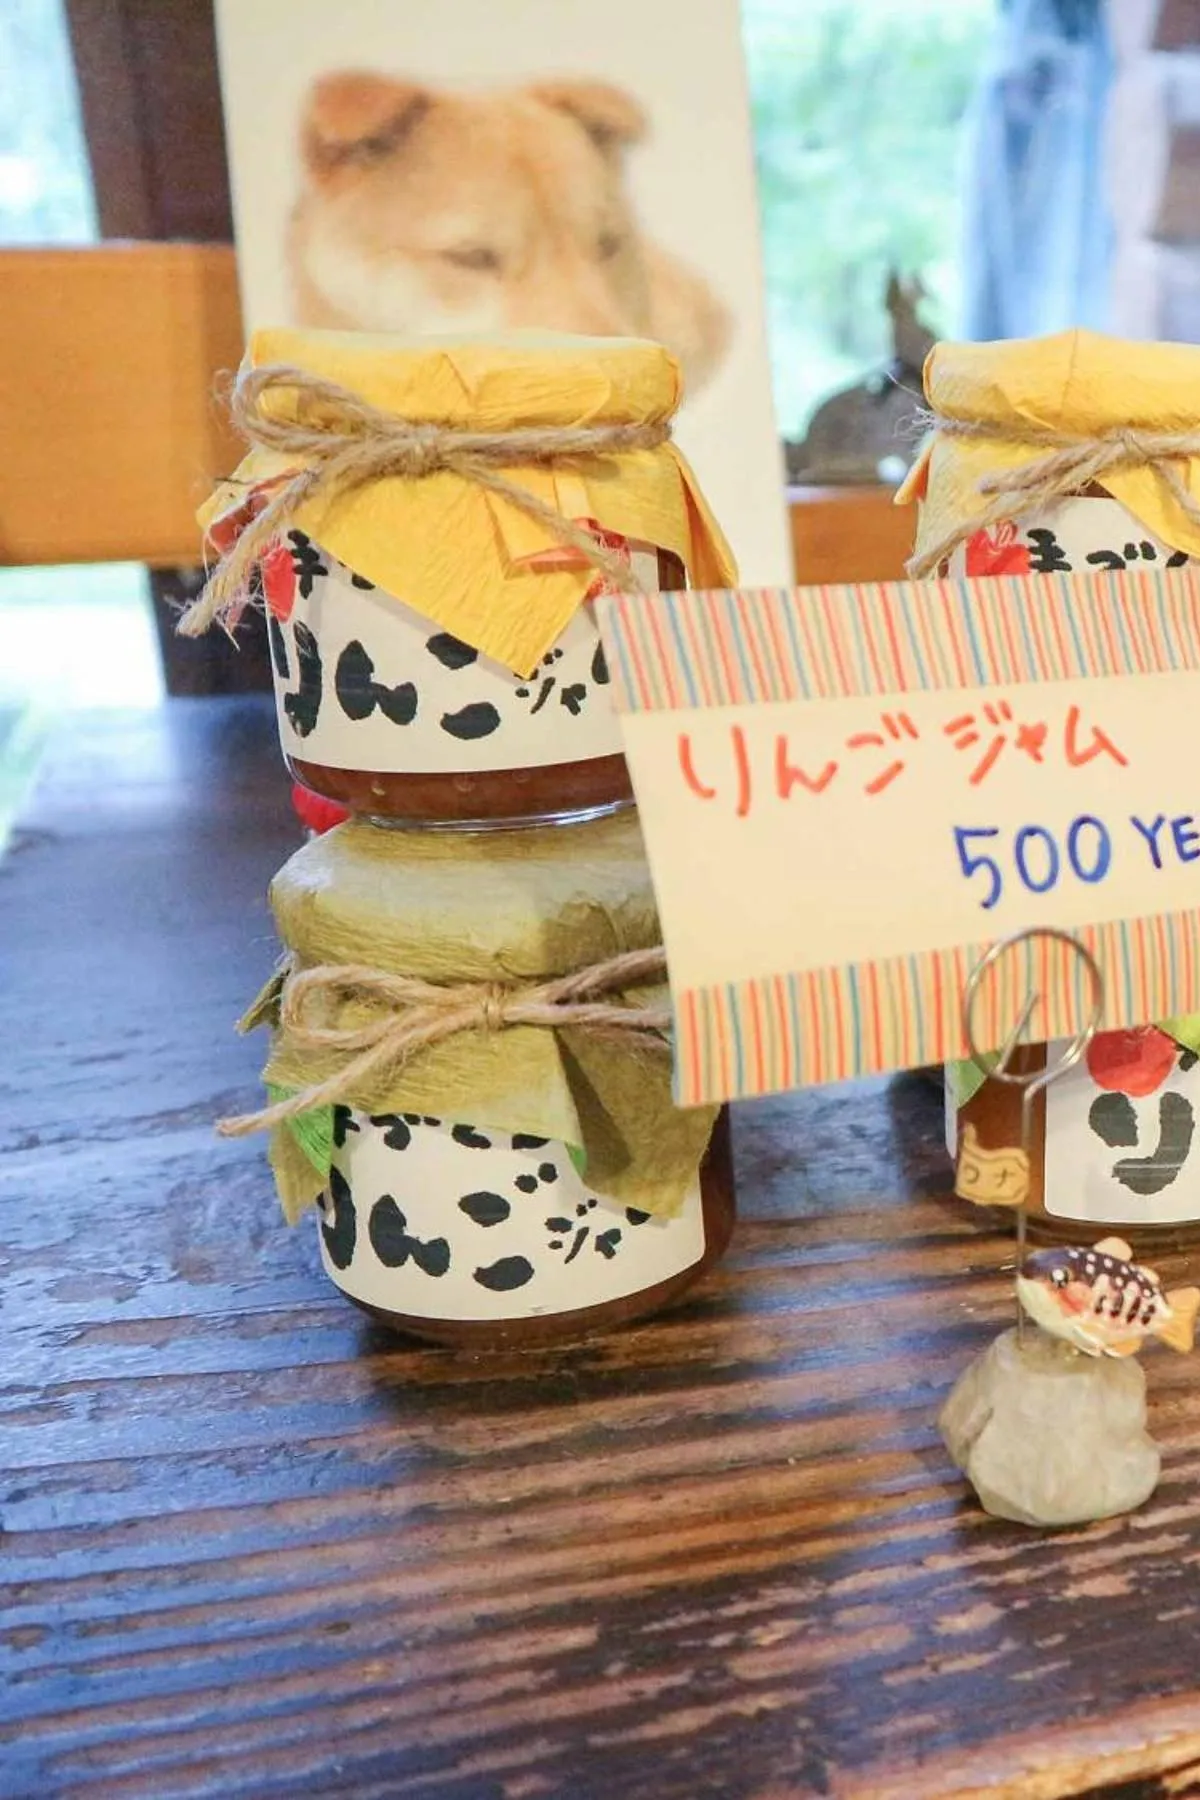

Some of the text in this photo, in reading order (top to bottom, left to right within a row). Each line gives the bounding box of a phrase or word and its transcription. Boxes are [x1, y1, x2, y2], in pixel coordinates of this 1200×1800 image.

[679, 702, 1129, 817] りんごジャム
[952, 816, 1112, 909] 500
